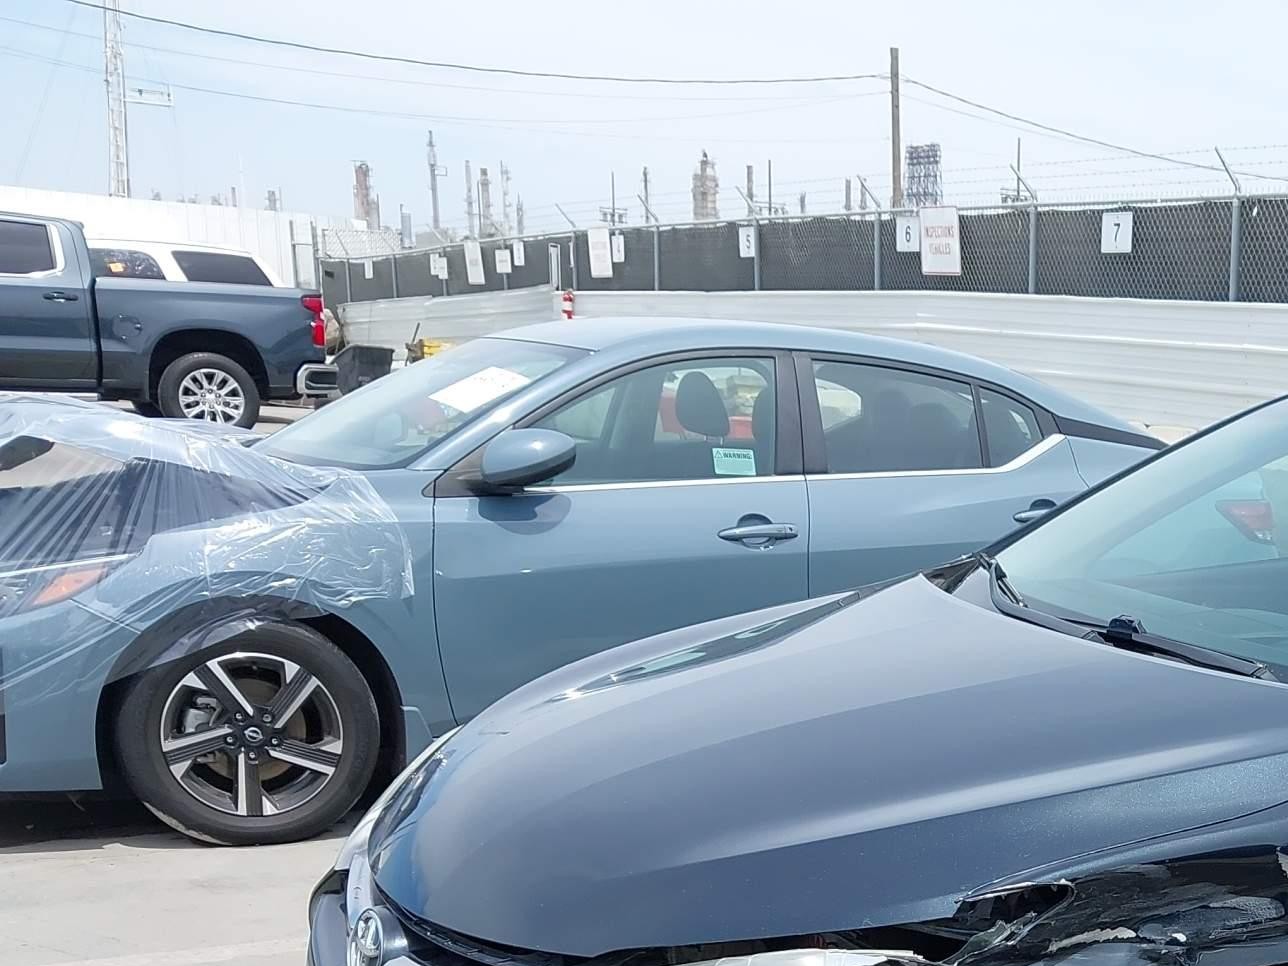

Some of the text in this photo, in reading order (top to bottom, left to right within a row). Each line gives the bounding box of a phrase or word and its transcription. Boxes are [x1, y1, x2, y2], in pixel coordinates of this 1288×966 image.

[905, 225, 911, 242] 6
[1113, 223, 1121, 242] 7
[746, 234, 751, 249] 5
